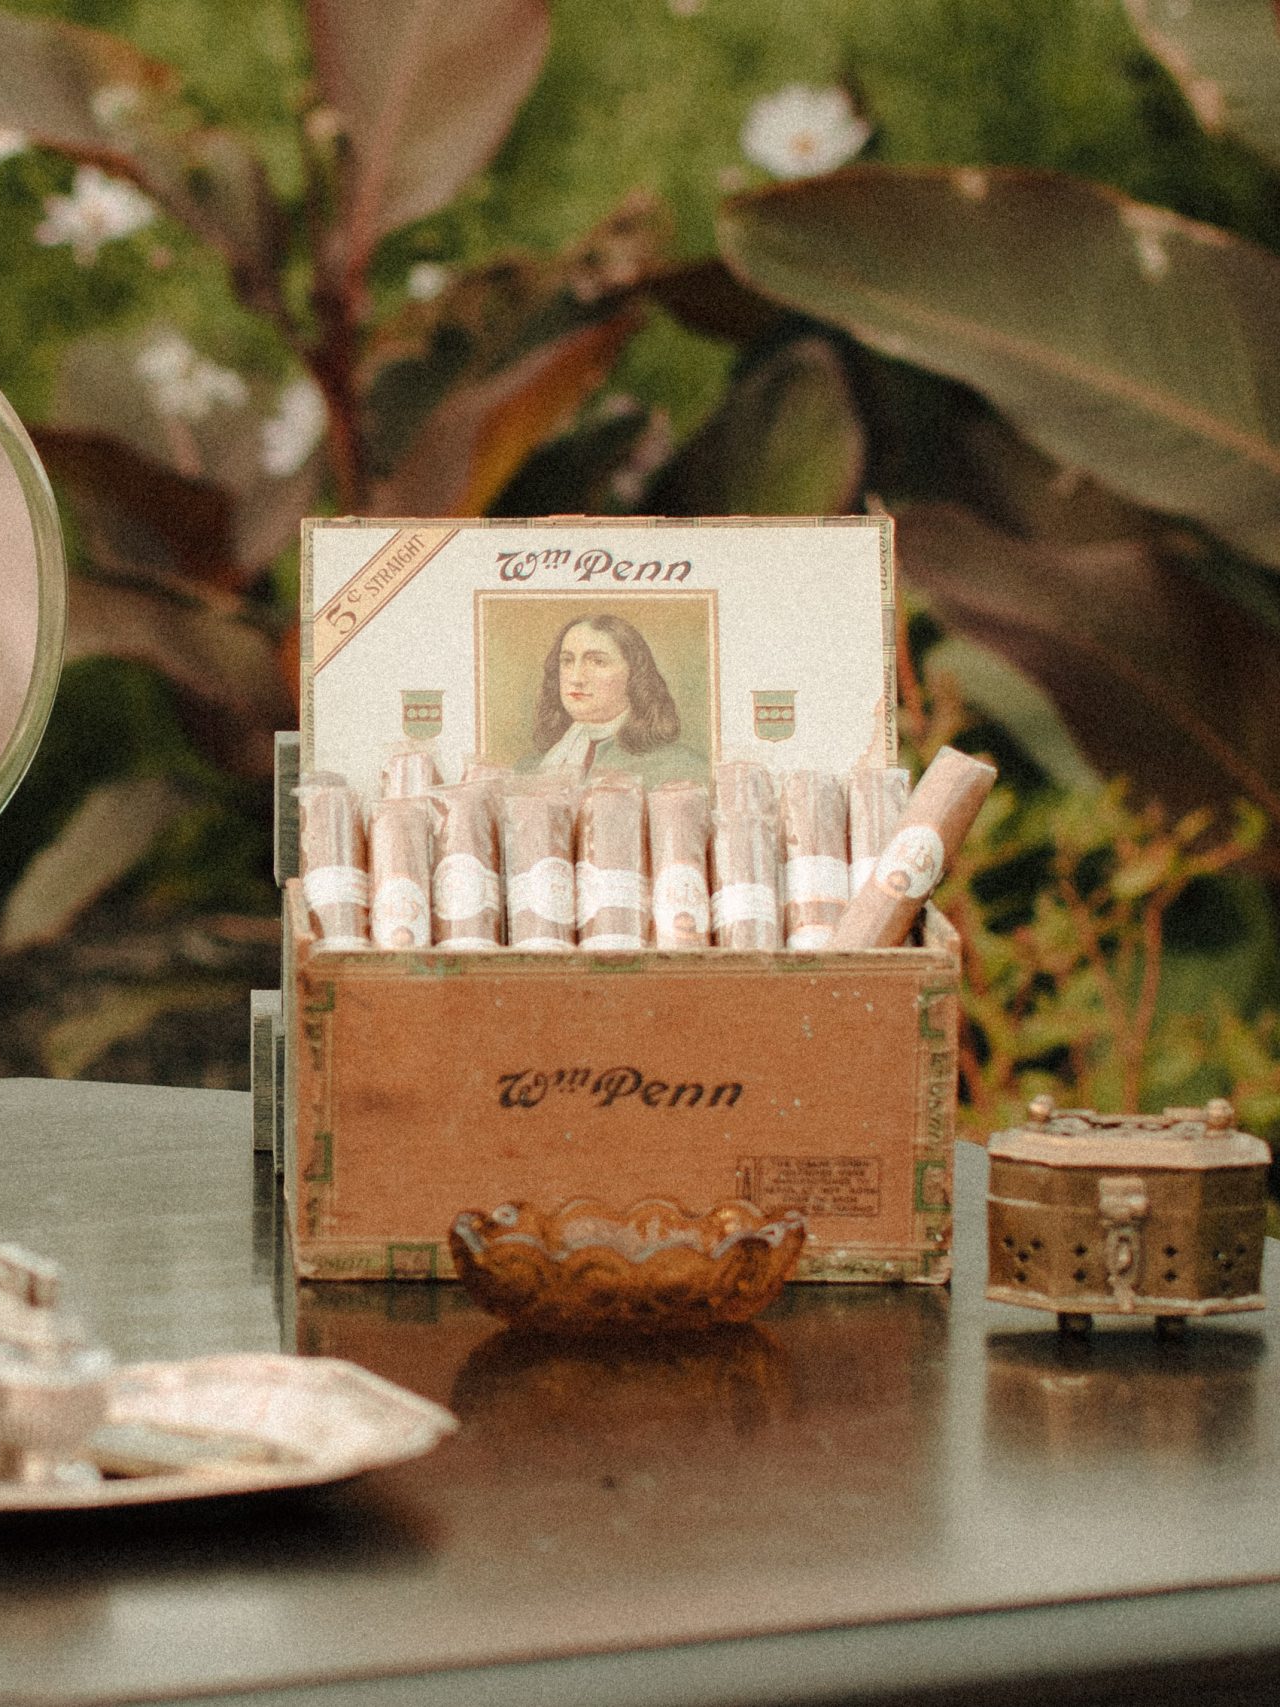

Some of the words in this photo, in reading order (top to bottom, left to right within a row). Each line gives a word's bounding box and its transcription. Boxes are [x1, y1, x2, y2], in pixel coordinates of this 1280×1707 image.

[363, 534, 428, 598] STRAIGHT
[573, 548, 692, 583] Penn
[591, 1065, 744, 1108] Penn
